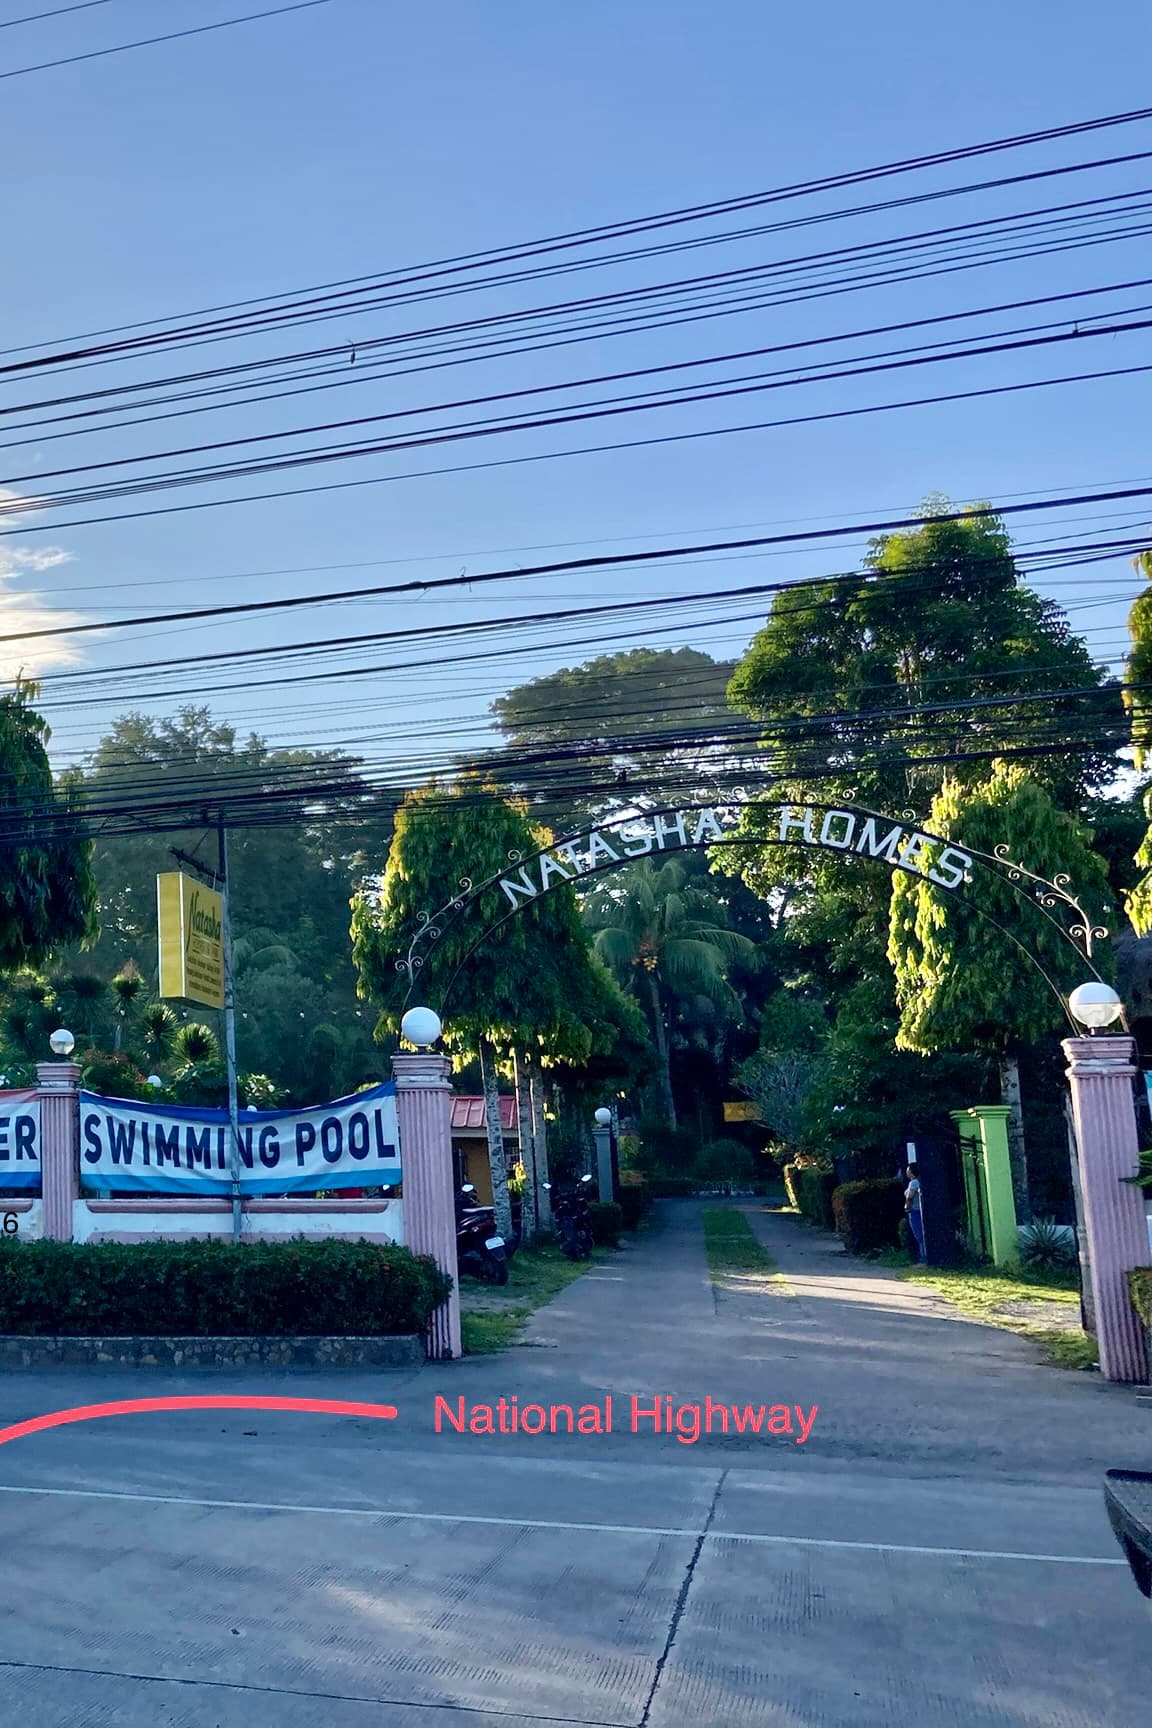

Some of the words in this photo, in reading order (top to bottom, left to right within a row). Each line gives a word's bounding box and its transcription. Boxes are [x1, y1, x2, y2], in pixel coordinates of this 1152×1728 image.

[498, 808, 725, 909] NATASHA
[779, 804, 974, 889] HOMES
[186, 890, 222, 953] Natasha
[83, 1114, 281, 1169] SWIMMING
[295, 1108, 396, 1167] POOL
